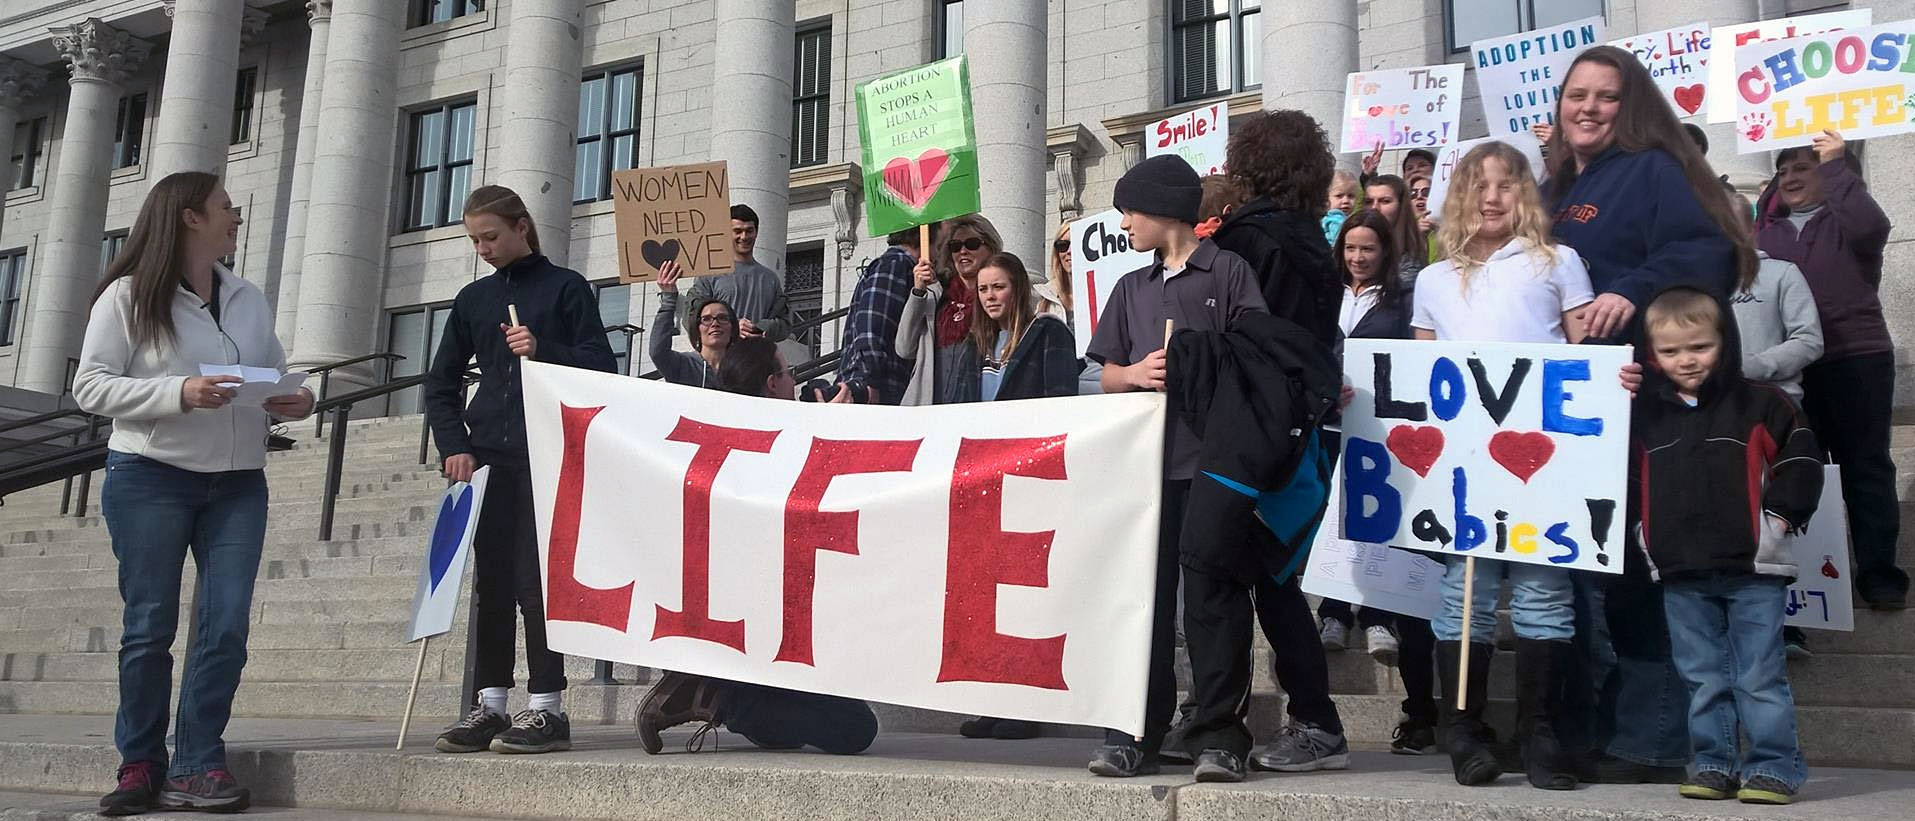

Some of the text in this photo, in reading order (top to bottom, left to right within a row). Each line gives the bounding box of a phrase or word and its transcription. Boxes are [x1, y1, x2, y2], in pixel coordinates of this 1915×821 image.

[1478, 25, 1595, 68] ADOPTION
[1667, 30, 1711, 56] Life
[872, 67, 941, 97] ABORTION
[1352, 69, 1448, 96] For The
[1520, 66, 1551, 83] THE
[880, 89, 933, 113] STOPS A
[1426, 94, 1447, 112] of
[1504, 84, 1562, 110] LOVIN
[886, 102, 938, 128] HUMAN
[1510, 112, 1553, 133] OPTI
[1771, 84, 1906, 140] LIFE
[892, 122, 938, 147] HEART
[1350, 118, 1451, 149] Babies!
[615, 168, 725, 202] WOMEN
[643, 209, 705, 237] NEED
[1082, 222, 1134, 262] Cho
[1373, 353, 1604, 436] LOVE
[547, 401, 1069, 691] LIFE
[1785, 590, 1829, 621] Lif
